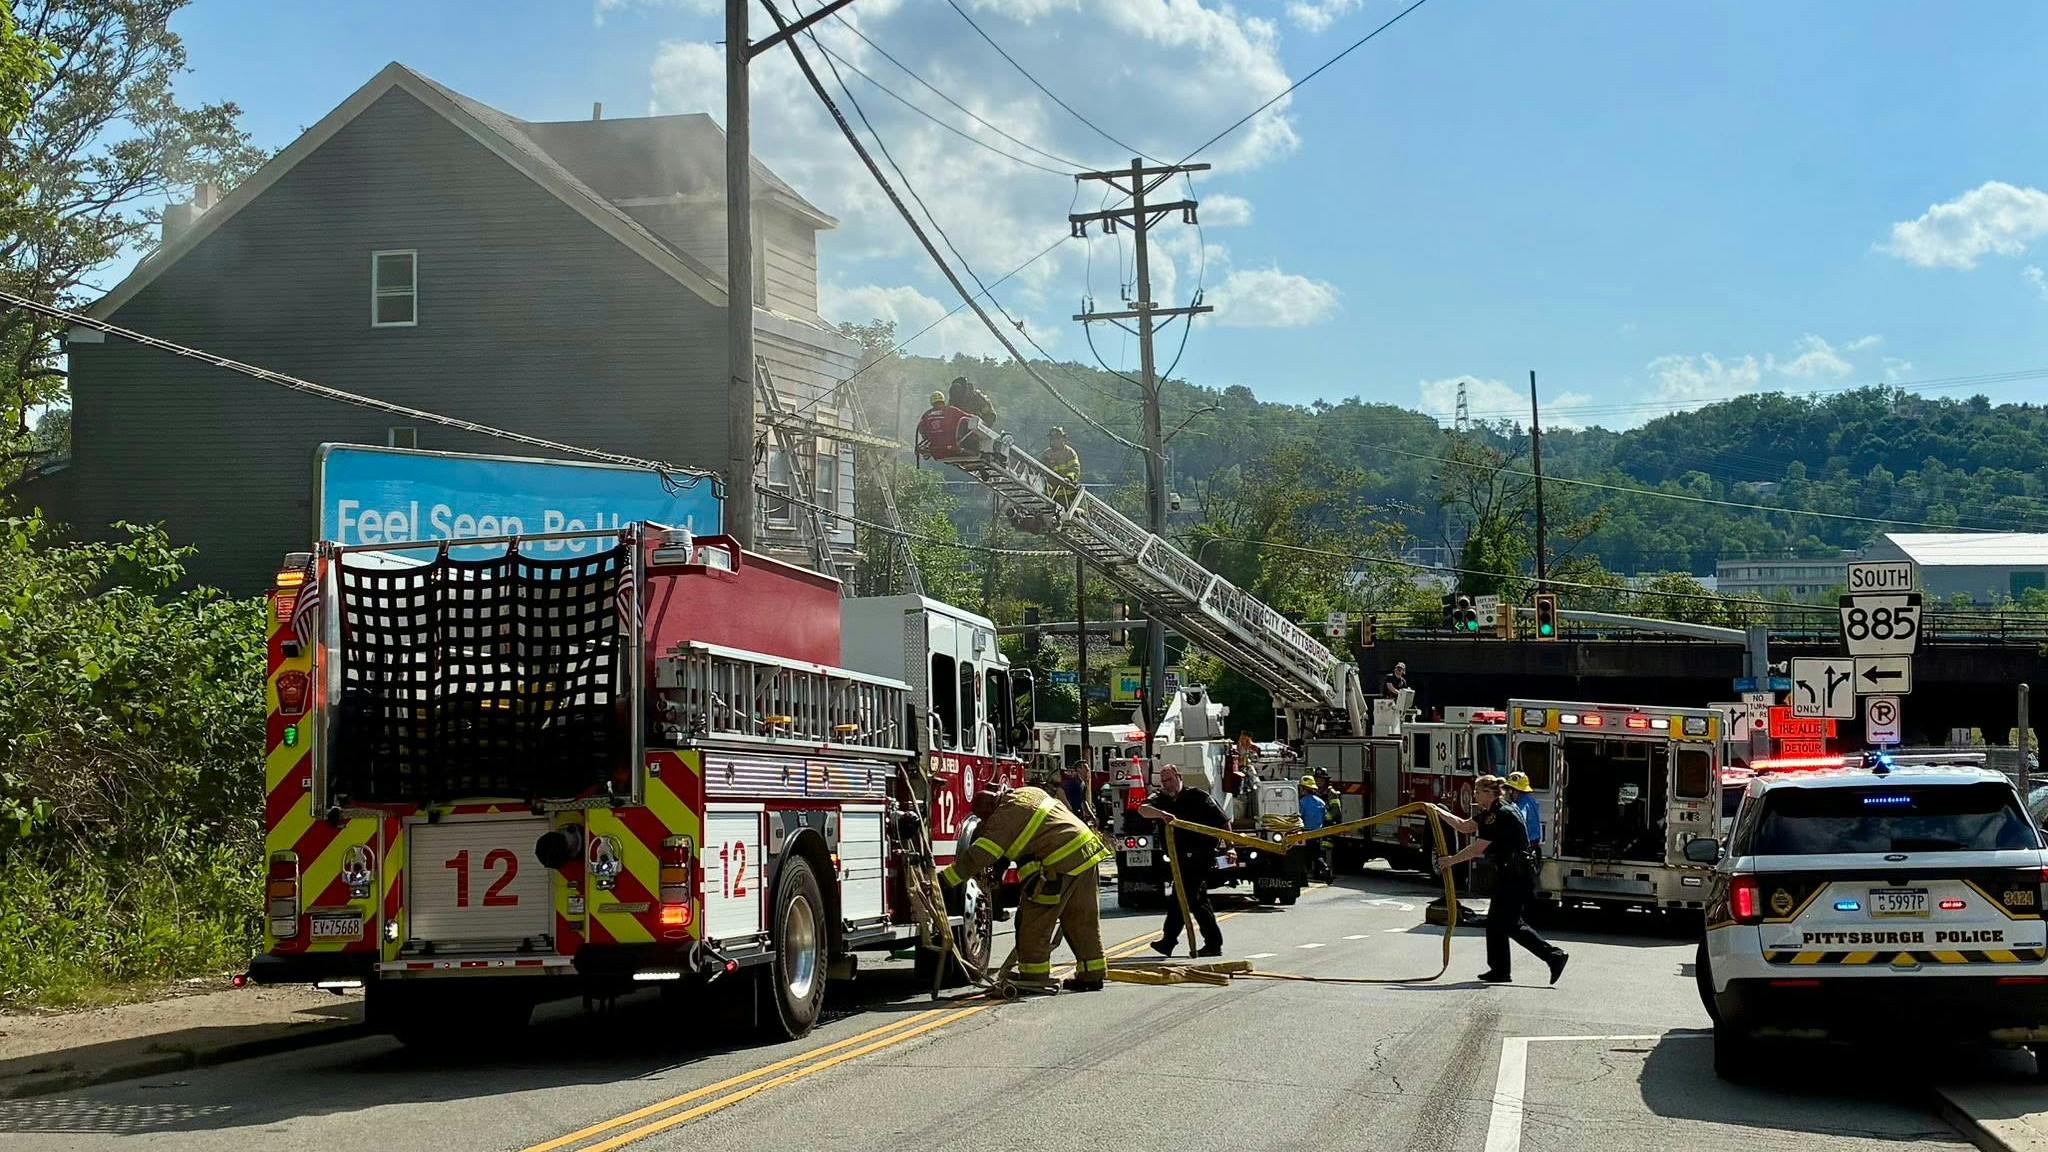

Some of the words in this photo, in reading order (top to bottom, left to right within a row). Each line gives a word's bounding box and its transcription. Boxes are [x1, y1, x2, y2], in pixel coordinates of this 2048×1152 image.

[337, 499, 418, 545] Feel
[543, 509, 585, 551] Be
[1852, 567, 1909, 587] SOUTH
[1847, 607, 1916, 640] 885
[1264, 608, 1280, 630] CITY
[1281, 620, 1290, 637] OF
[1291, 626, 1329, 664] PITTSBURGH
[1797, 705, 1821, 713] ONLY
[1779, 725, 1796, 735] THE
[1798, 724, 1827, 735] ALLIE
[1436, 742, 1446, 761] 13
[1785, 743, 1822, 753] DETOUR
[938, 790, 954, 834] 12
[445, 848, 520, 908] 12
[719, 840, 747, 899] 12
[1888, 895, 1925, 911] 5997P
[1803, 931, 1924, 944] PITTSBURGH
[1935, 930, 2004, 943] POLICE
